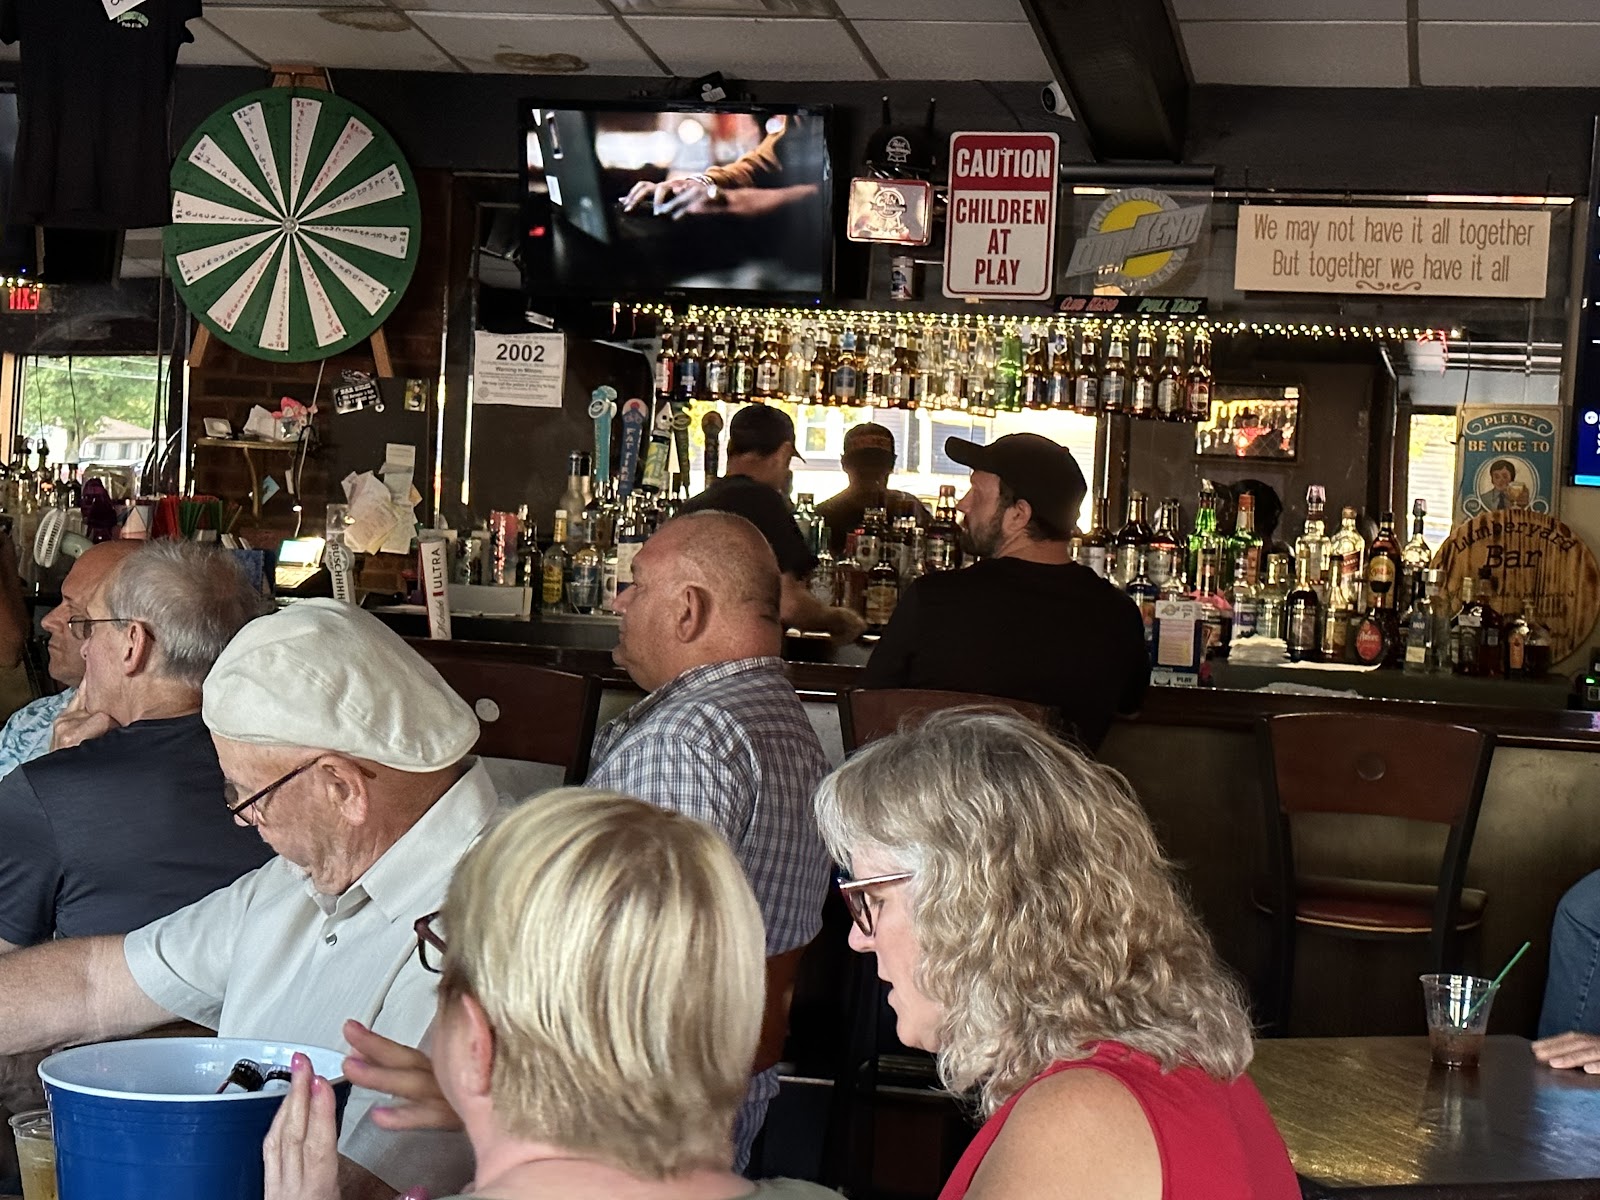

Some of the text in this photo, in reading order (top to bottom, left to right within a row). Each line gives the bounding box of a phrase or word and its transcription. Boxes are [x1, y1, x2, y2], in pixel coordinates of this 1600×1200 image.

[956, 148, 1050, 178] CAUTION
[955, 198, 1046, 224] CHILDREN
[987, 229, 1011, 254] AT
[1130, 213, 1200, 253] KENO
[1253, 213, 1535, 250] We may not have it all together
[974, 259, 1020, 285] PLAY
[1272, 250, 1510, 282] But together we have it all
[1137, 298, 1202, 313] PULL TABS
[496, 343, 545, 362] 2002
[1483, 413, 1537, 427] PLEASE
[1468, 440, 1550, 453] BE NICE TO
[1451, 520, 1578, 554] Lumberyard
[431, 548, 443, 589] ULTRA
[1483, 545, 1542, 568] Bar
